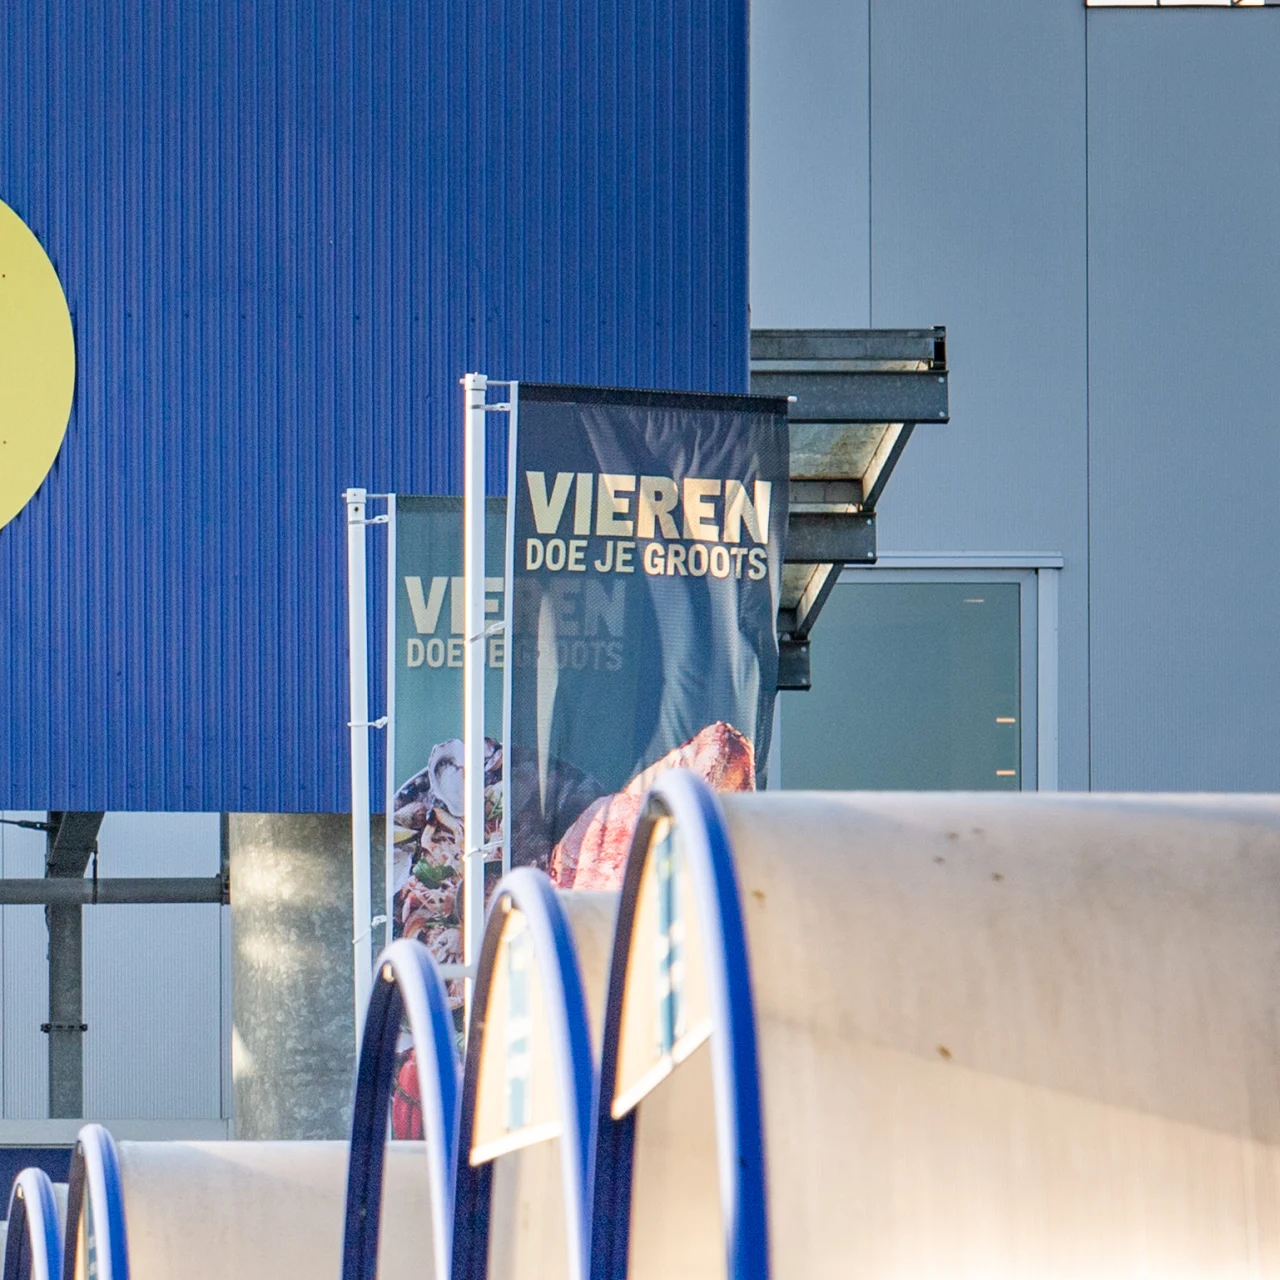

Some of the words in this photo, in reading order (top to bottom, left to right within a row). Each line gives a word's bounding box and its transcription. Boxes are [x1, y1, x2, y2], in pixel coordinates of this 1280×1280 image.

[526, 471, 772, 545] VIEREN
[526, 538, 587, 572] DOE
[594, 541, 635, 573] JE
[643, 543, 768, 581] GROOTS
[407, 638, 464, 668] DOE
